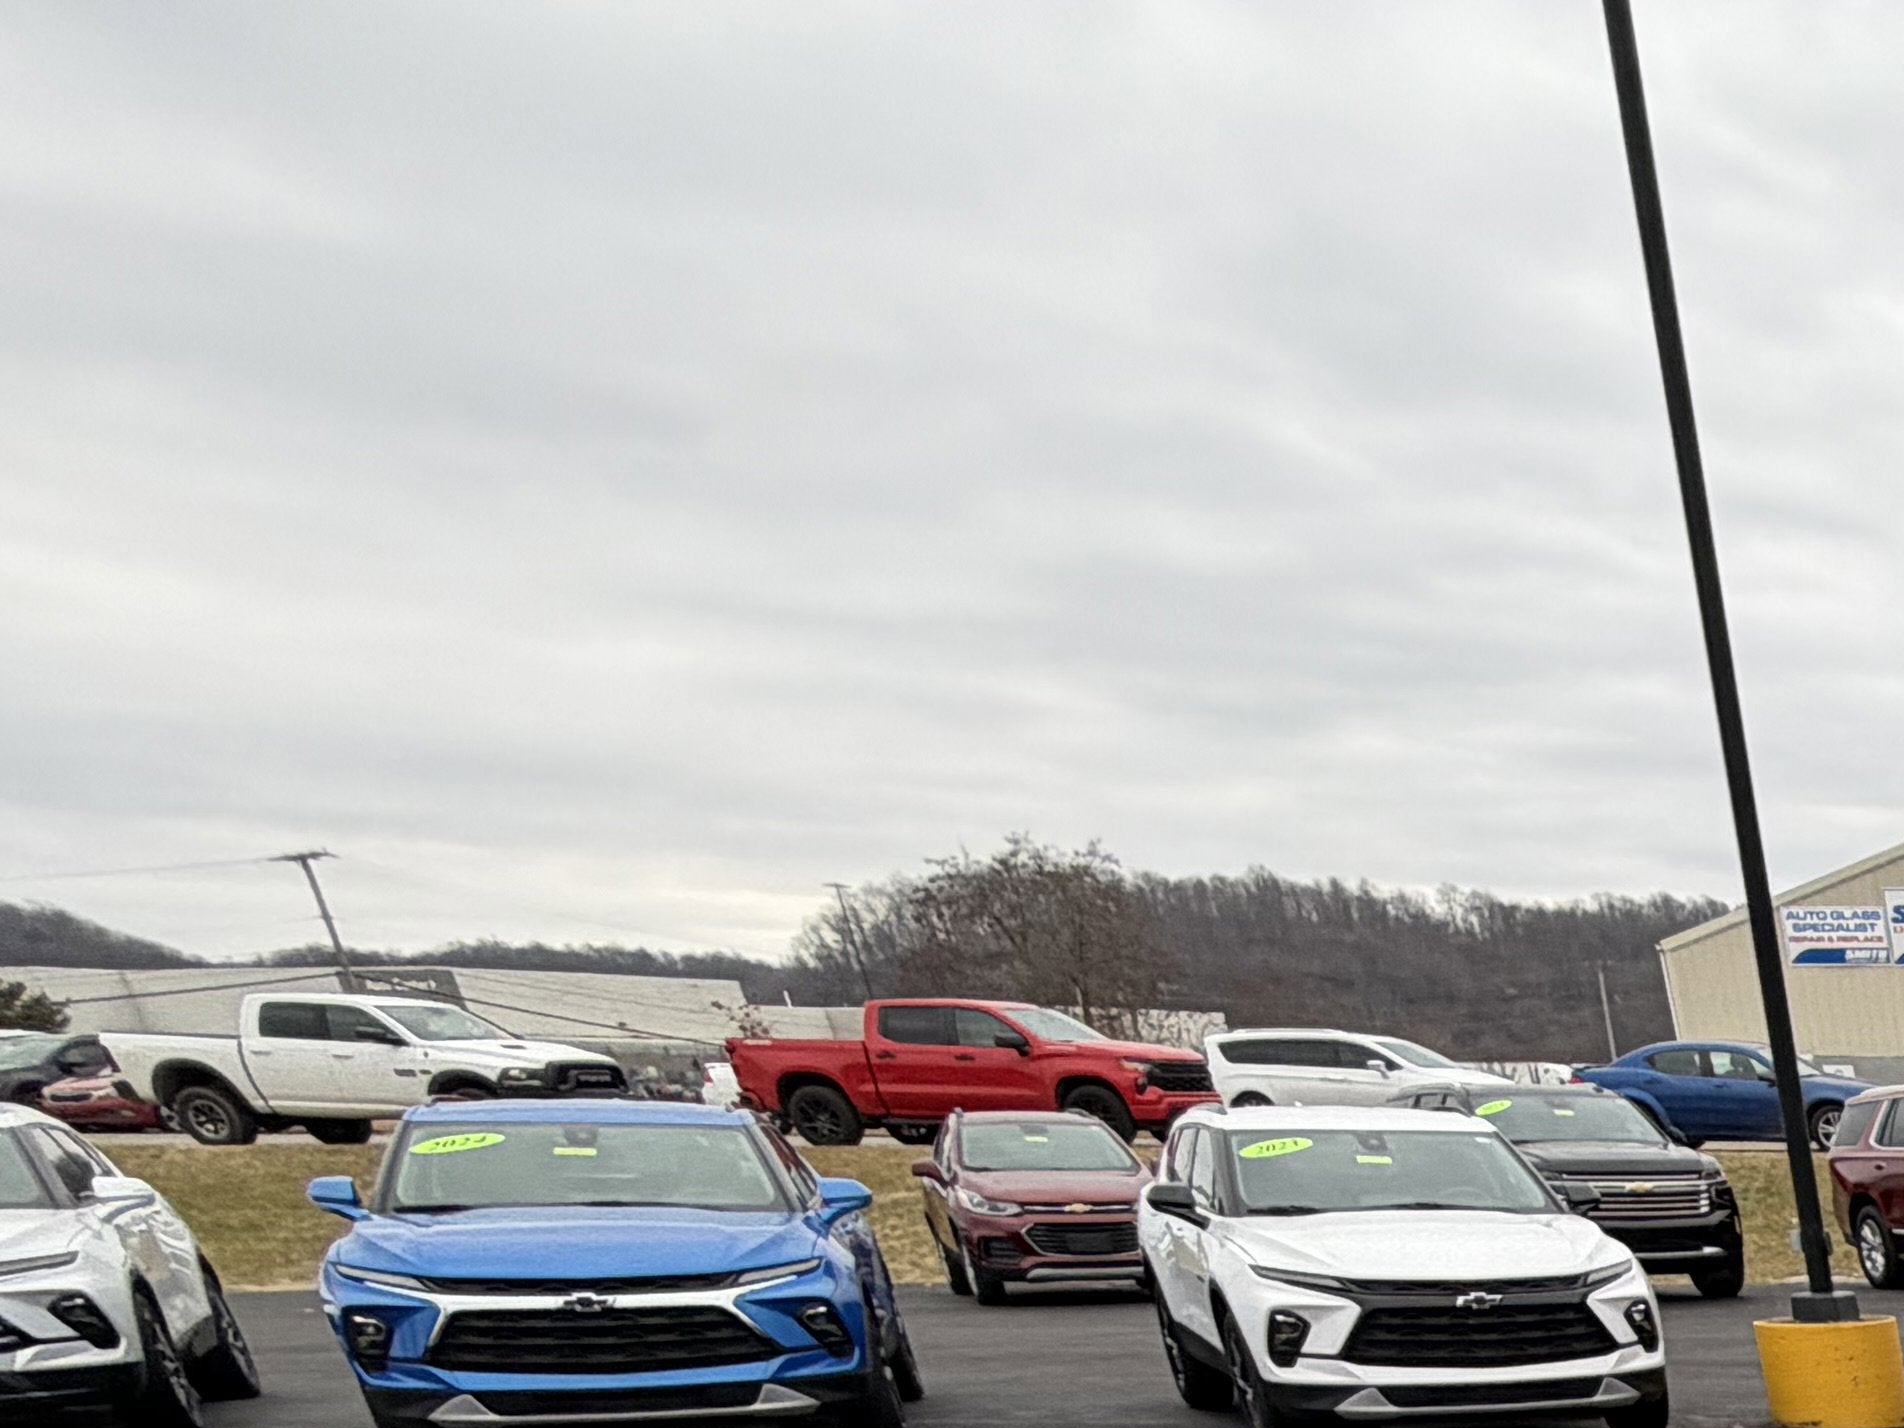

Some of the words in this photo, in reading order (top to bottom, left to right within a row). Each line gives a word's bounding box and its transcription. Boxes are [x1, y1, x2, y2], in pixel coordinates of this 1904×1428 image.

[1786, 911, 1828, 921] AUTO
[1830, 911, 1882, 921] GLASS
[1792, 922, 1878, 933] SPECIALIST
